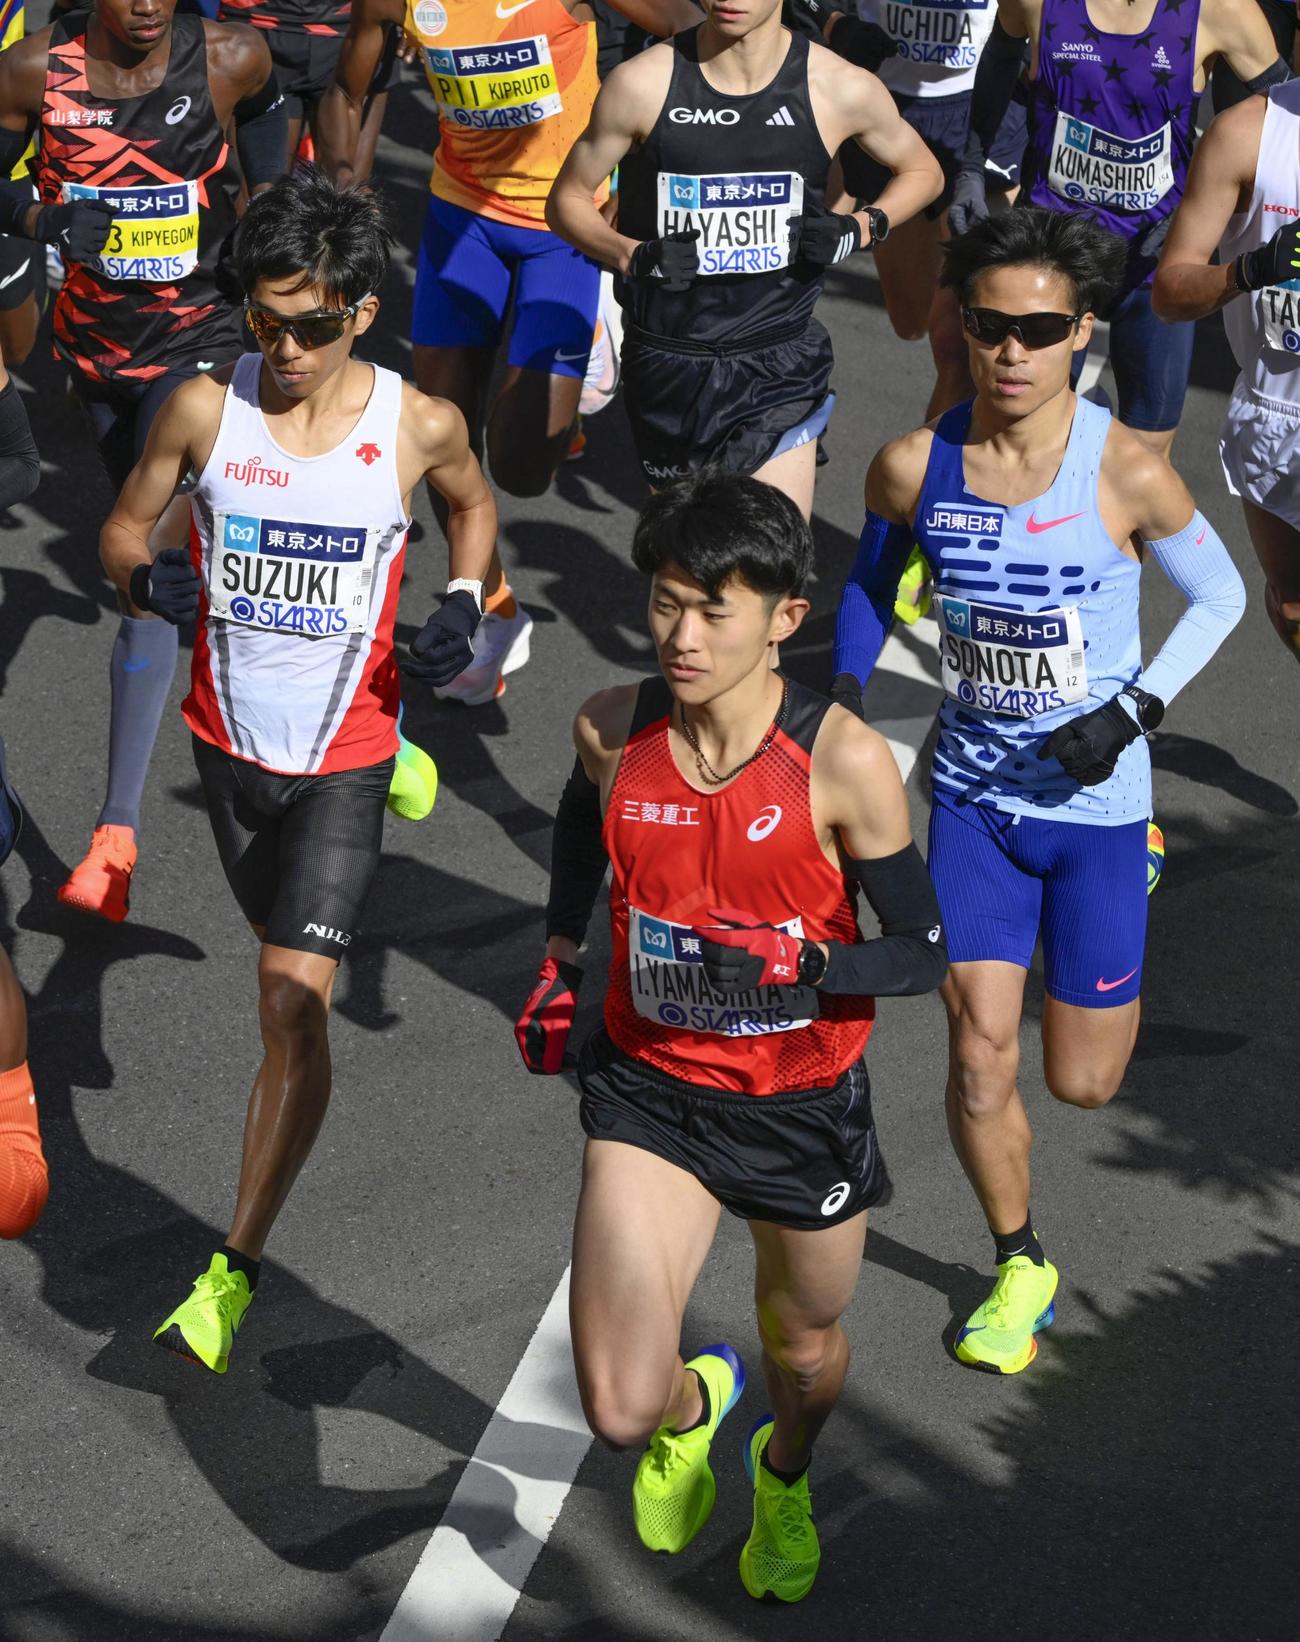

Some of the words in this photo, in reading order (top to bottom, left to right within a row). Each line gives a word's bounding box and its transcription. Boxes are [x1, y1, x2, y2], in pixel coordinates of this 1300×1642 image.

[887, 3, 972, 44] UCHIDA
[458, 48, 533, 70] 東京メトロ
[911, 42, 977, 67] STARTS
[1052, 51, 1080, 60] SPECIAL
[1081, 53, 1102, 62] STEEL
[1061, 42, 1094, 53] SANYO
[488, 73, 550, 101] KIPRUTO
[50, 110, 114, 126] 山梨学院
[473, 102, 544, 128] STARTS
[668, 107, 741, 125] GMO
[1094, 138, 1161, 159] 東京メトロ
[1054, 144, 1155, 191] KUMASHIRO
[705, 183, 785, 201] 東京メトロ
[1087, 187, 1159, 209] STARTS
[131, 225, 194, 247] KIPYEGON
[664, 209, 776, 248] HAYASHI
[106, 256, 184, 280] STARTS
[703, 245, 782, 273] STARTS
[1266, 289, 1300, 328] TA
[224, 456, 289, 487] FUJITSU
[926, 511, 1000, 533] JR東日本
[267, 530, 359, 553] 東京メトロ
[222, 553, 340, 605] SUZUKI
[352, 595, 362, 606] 10
[257, 601, 348, 634] STARTS
[976, 616, 1060, 640] 東京メトロ
[946, 635, 1057, 689] SONOTA
[1066, 675, 1078, 687] 12
[979, 684, 1066, 715] STARTS
[621, 800, 700, 826] 三菱重工
